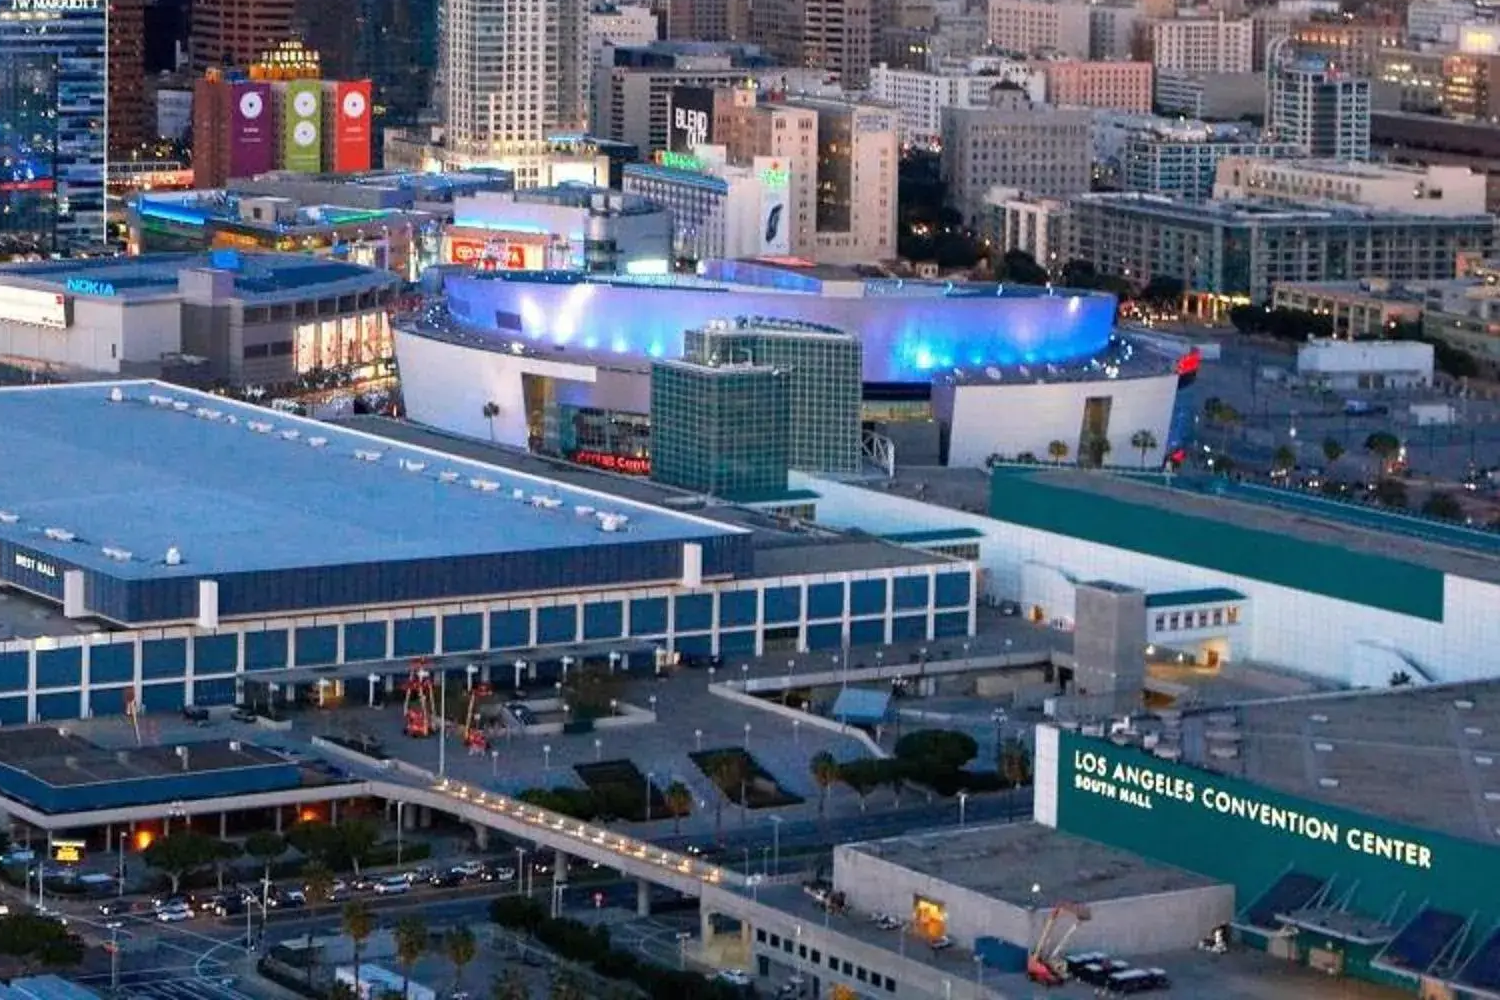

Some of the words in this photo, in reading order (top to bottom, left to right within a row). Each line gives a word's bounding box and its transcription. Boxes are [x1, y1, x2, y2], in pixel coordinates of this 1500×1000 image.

[67, 278, 116, 297] NOKIA
[1075, 774, 1116, 799] SOUTH
[1119, 788, 1153, 809] HALL
[1075, 750, 1108, 777] LOS
[1112, 762, 1195, 803] ANGELES
[1202, 788, 1339, 844] CONVENTION
[1346, 828, 1432, 869] CENTER
